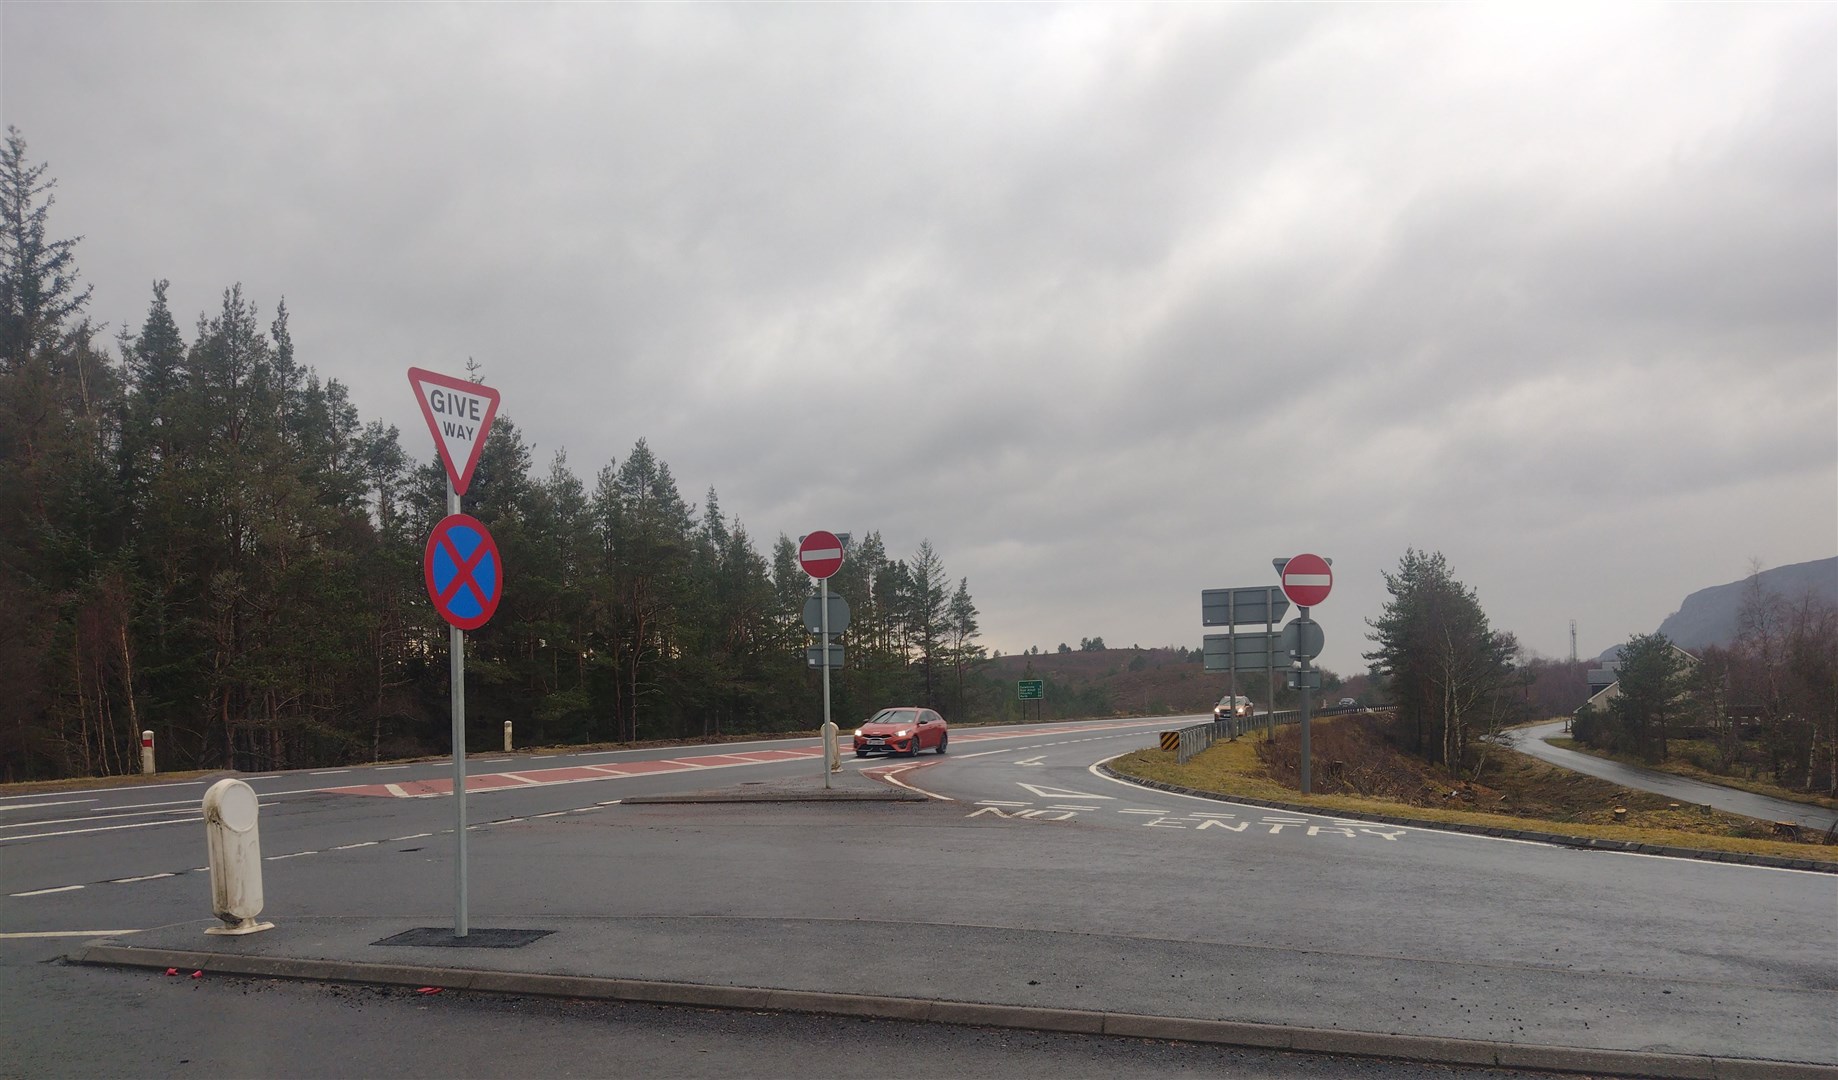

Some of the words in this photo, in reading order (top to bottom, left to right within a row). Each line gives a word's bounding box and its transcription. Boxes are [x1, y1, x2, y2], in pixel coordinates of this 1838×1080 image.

[430, 389, 481, 422] GIVE
[443, 421, 474, 441] WAY
[965, 806, 1079, 821] NO
[1142, 816, 1407, 841] ENTRY
